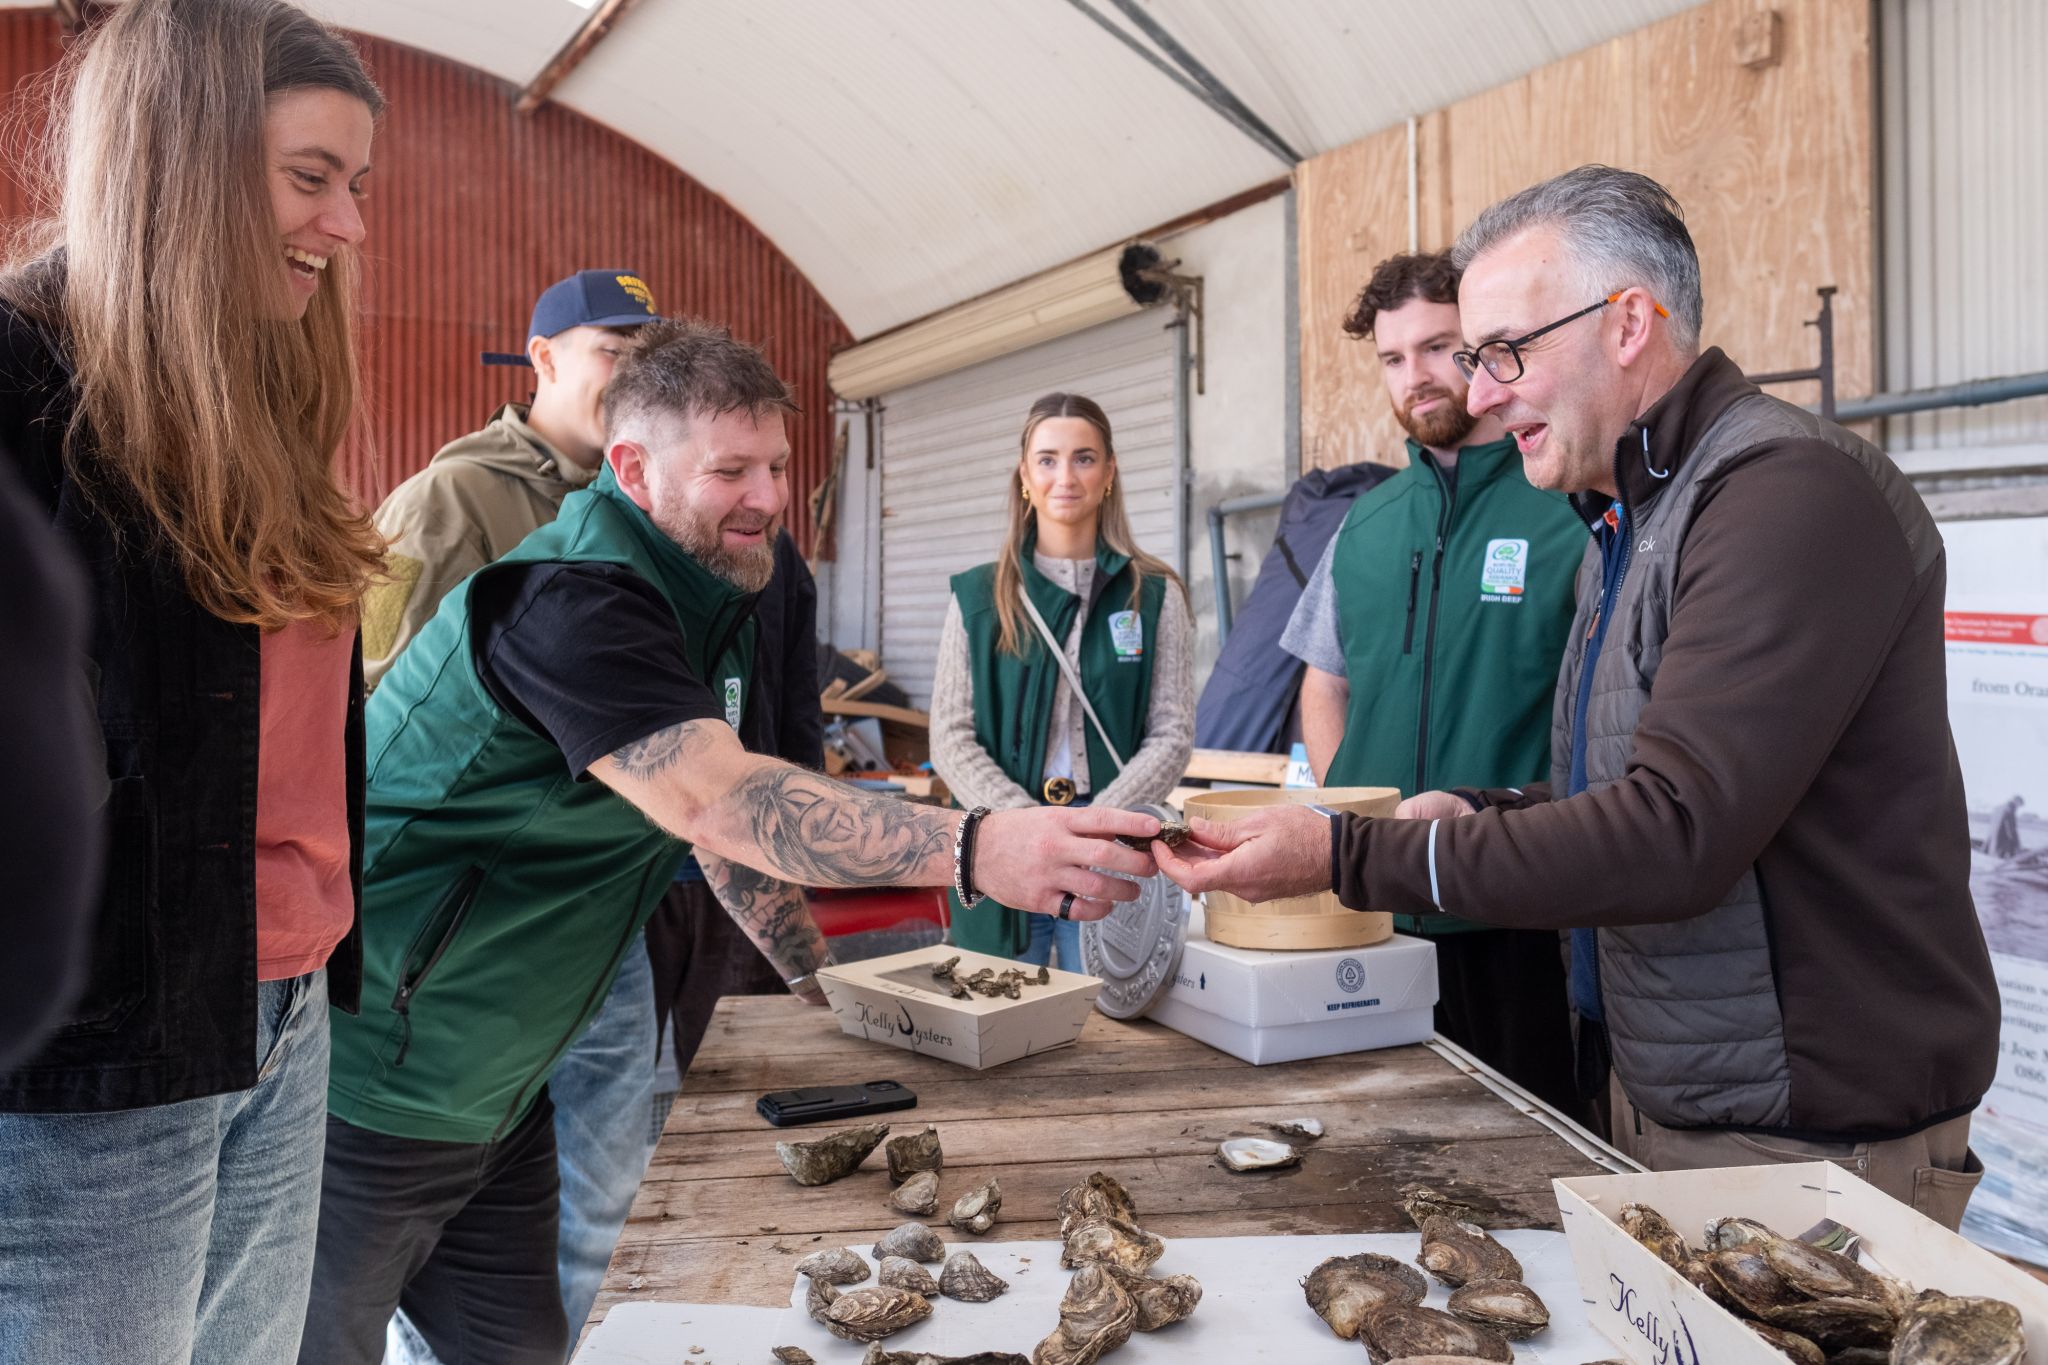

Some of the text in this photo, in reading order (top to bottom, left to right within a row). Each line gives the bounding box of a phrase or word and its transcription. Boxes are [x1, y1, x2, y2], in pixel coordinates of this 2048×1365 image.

[1638, 535, 1656, 553] ck
[1487, 567, 1521, 576] QUALITY
[1972, 677, 2048, 698] from Ora
[1327, 998, 1380, 1011] KEEP REFRIGERATED
[855, 1001, 895, 1038] Kelly
[1610, 1272, 1669, 1365] Kelly
